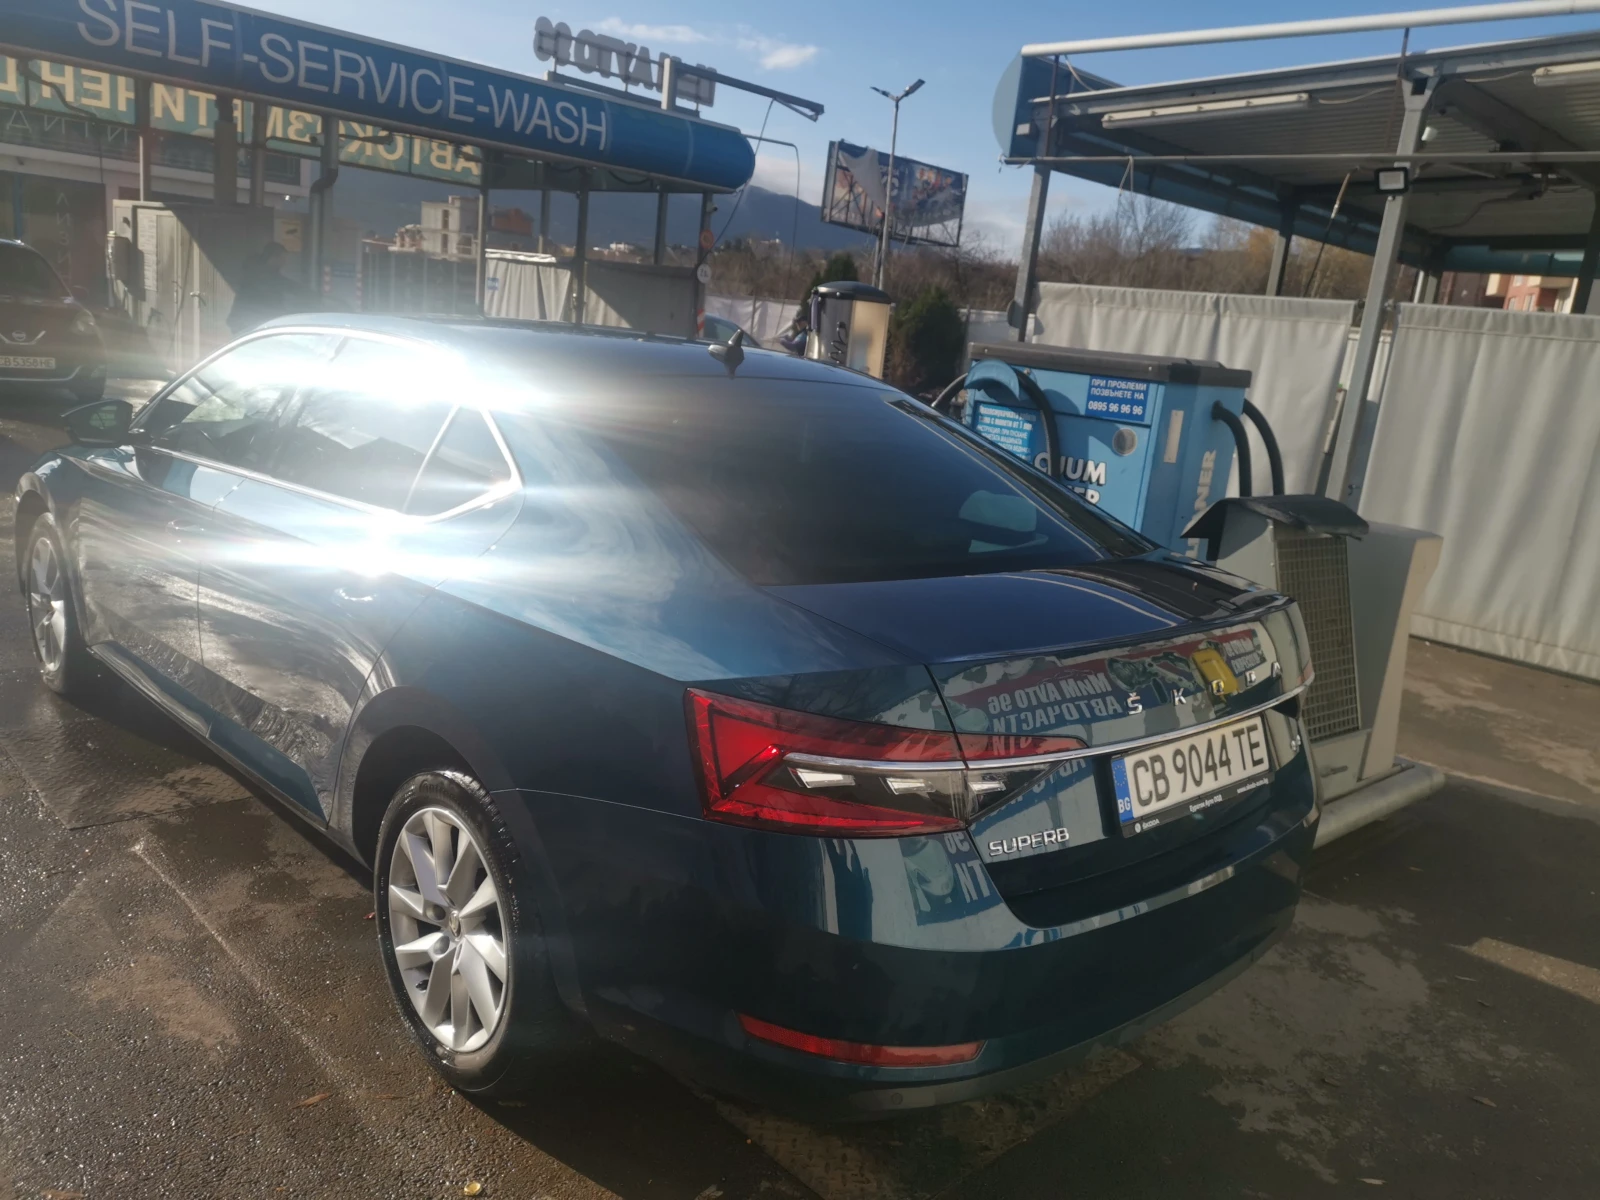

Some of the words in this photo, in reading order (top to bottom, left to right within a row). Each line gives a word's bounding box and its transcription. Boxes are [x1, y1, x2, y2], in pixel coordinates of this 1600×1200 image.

[77, 0, 608, 151] SELF-SERVICE-WASH
[1090, 388, 1132, 399] ПОЗВЪНЕТЕ
[1134, 392, 1144, 400] НА
[1091, 378, 1106, 388] ПРИ
[1107, 380, 1147, 391] ПРОБЛЕМИ
[1088, 400, 1107, 411] 0895
[1108, 403, 1119, 412] 96
[1120, 404, 1131, 414] 96
[1132, 405, 1143, 415] 96
[1117, 797, 1131, 814] BG
[1132, 754, 1171, 807] CB
[1172, 733, 1232, 794] 9044
[1232, 723, 1264, 771] TE
[988, 827, 1070, 857] SUPERB
